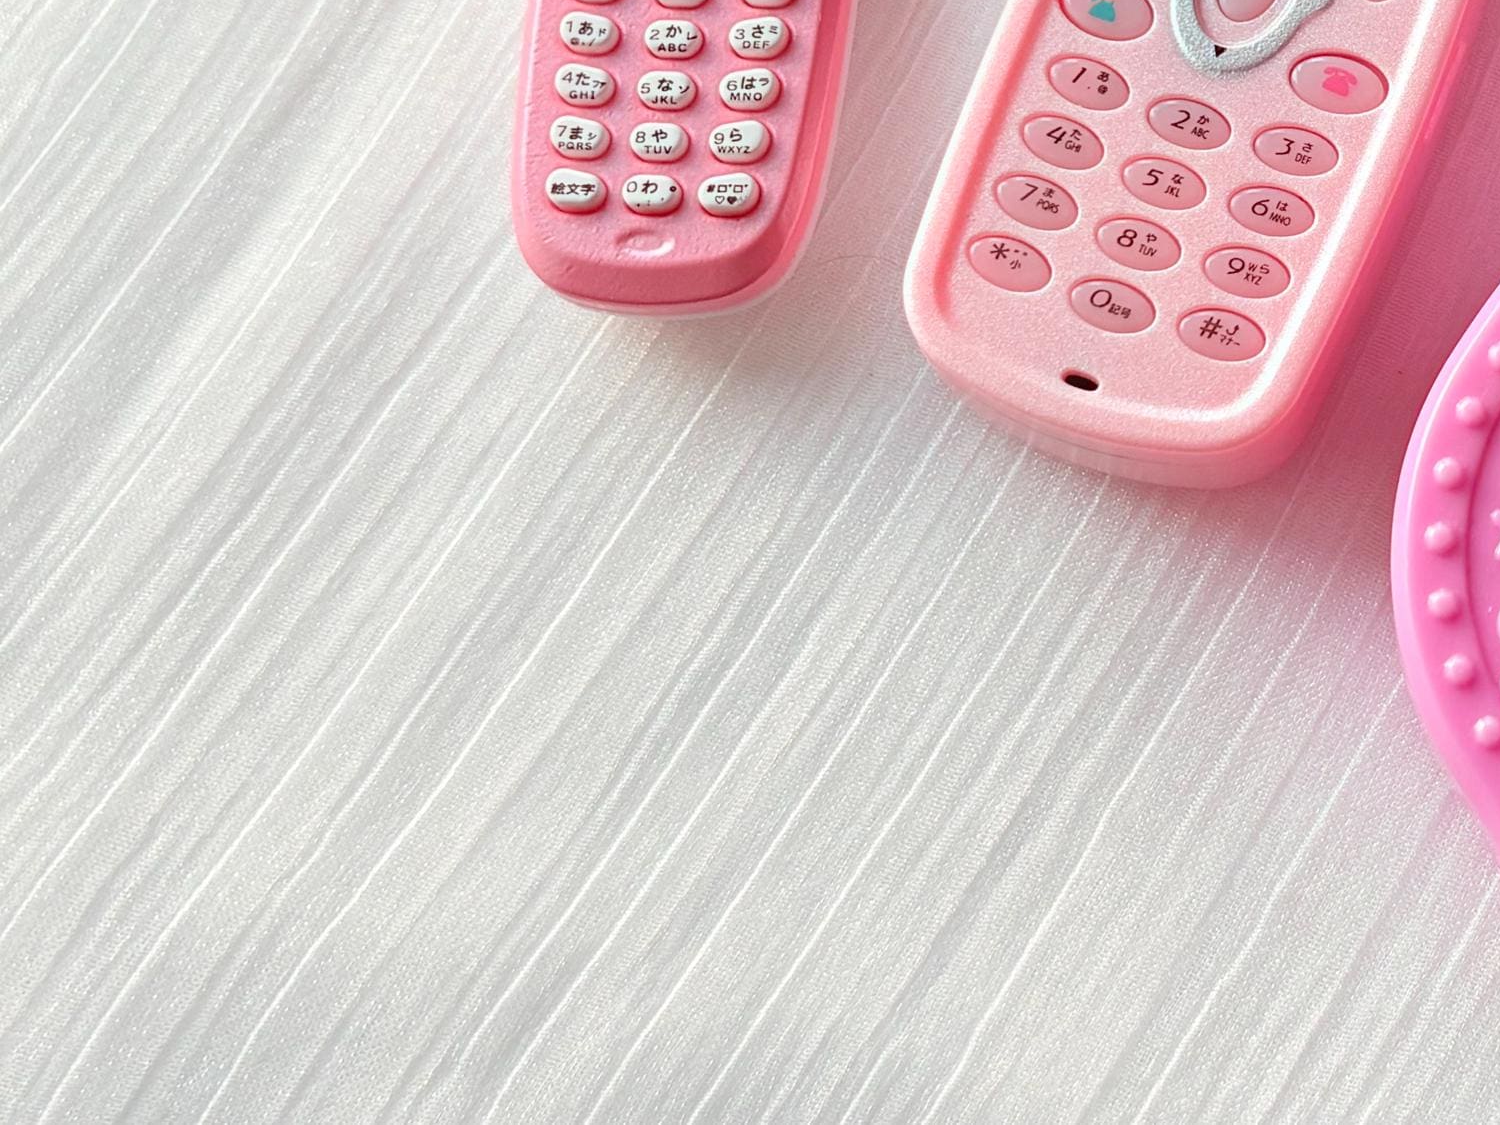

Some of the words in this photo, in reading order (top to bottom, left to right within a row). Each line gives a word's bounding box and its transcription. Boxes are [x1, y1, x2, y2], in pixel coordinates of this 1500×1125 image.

[657, 43, 687, 53] ABC
[742, 40, 771, 50] DEF
[569, 90, 596, 100] GHI
[651, 96, 678, 104] JKL
[730, 92, 763, 101] MNO
[558, 141, 593, 151] PQRS
[644, 145, 673, 154] TUV
[717, 146, 751, 154] WXYZ
[551, 182, 596, 196] 絵文字
